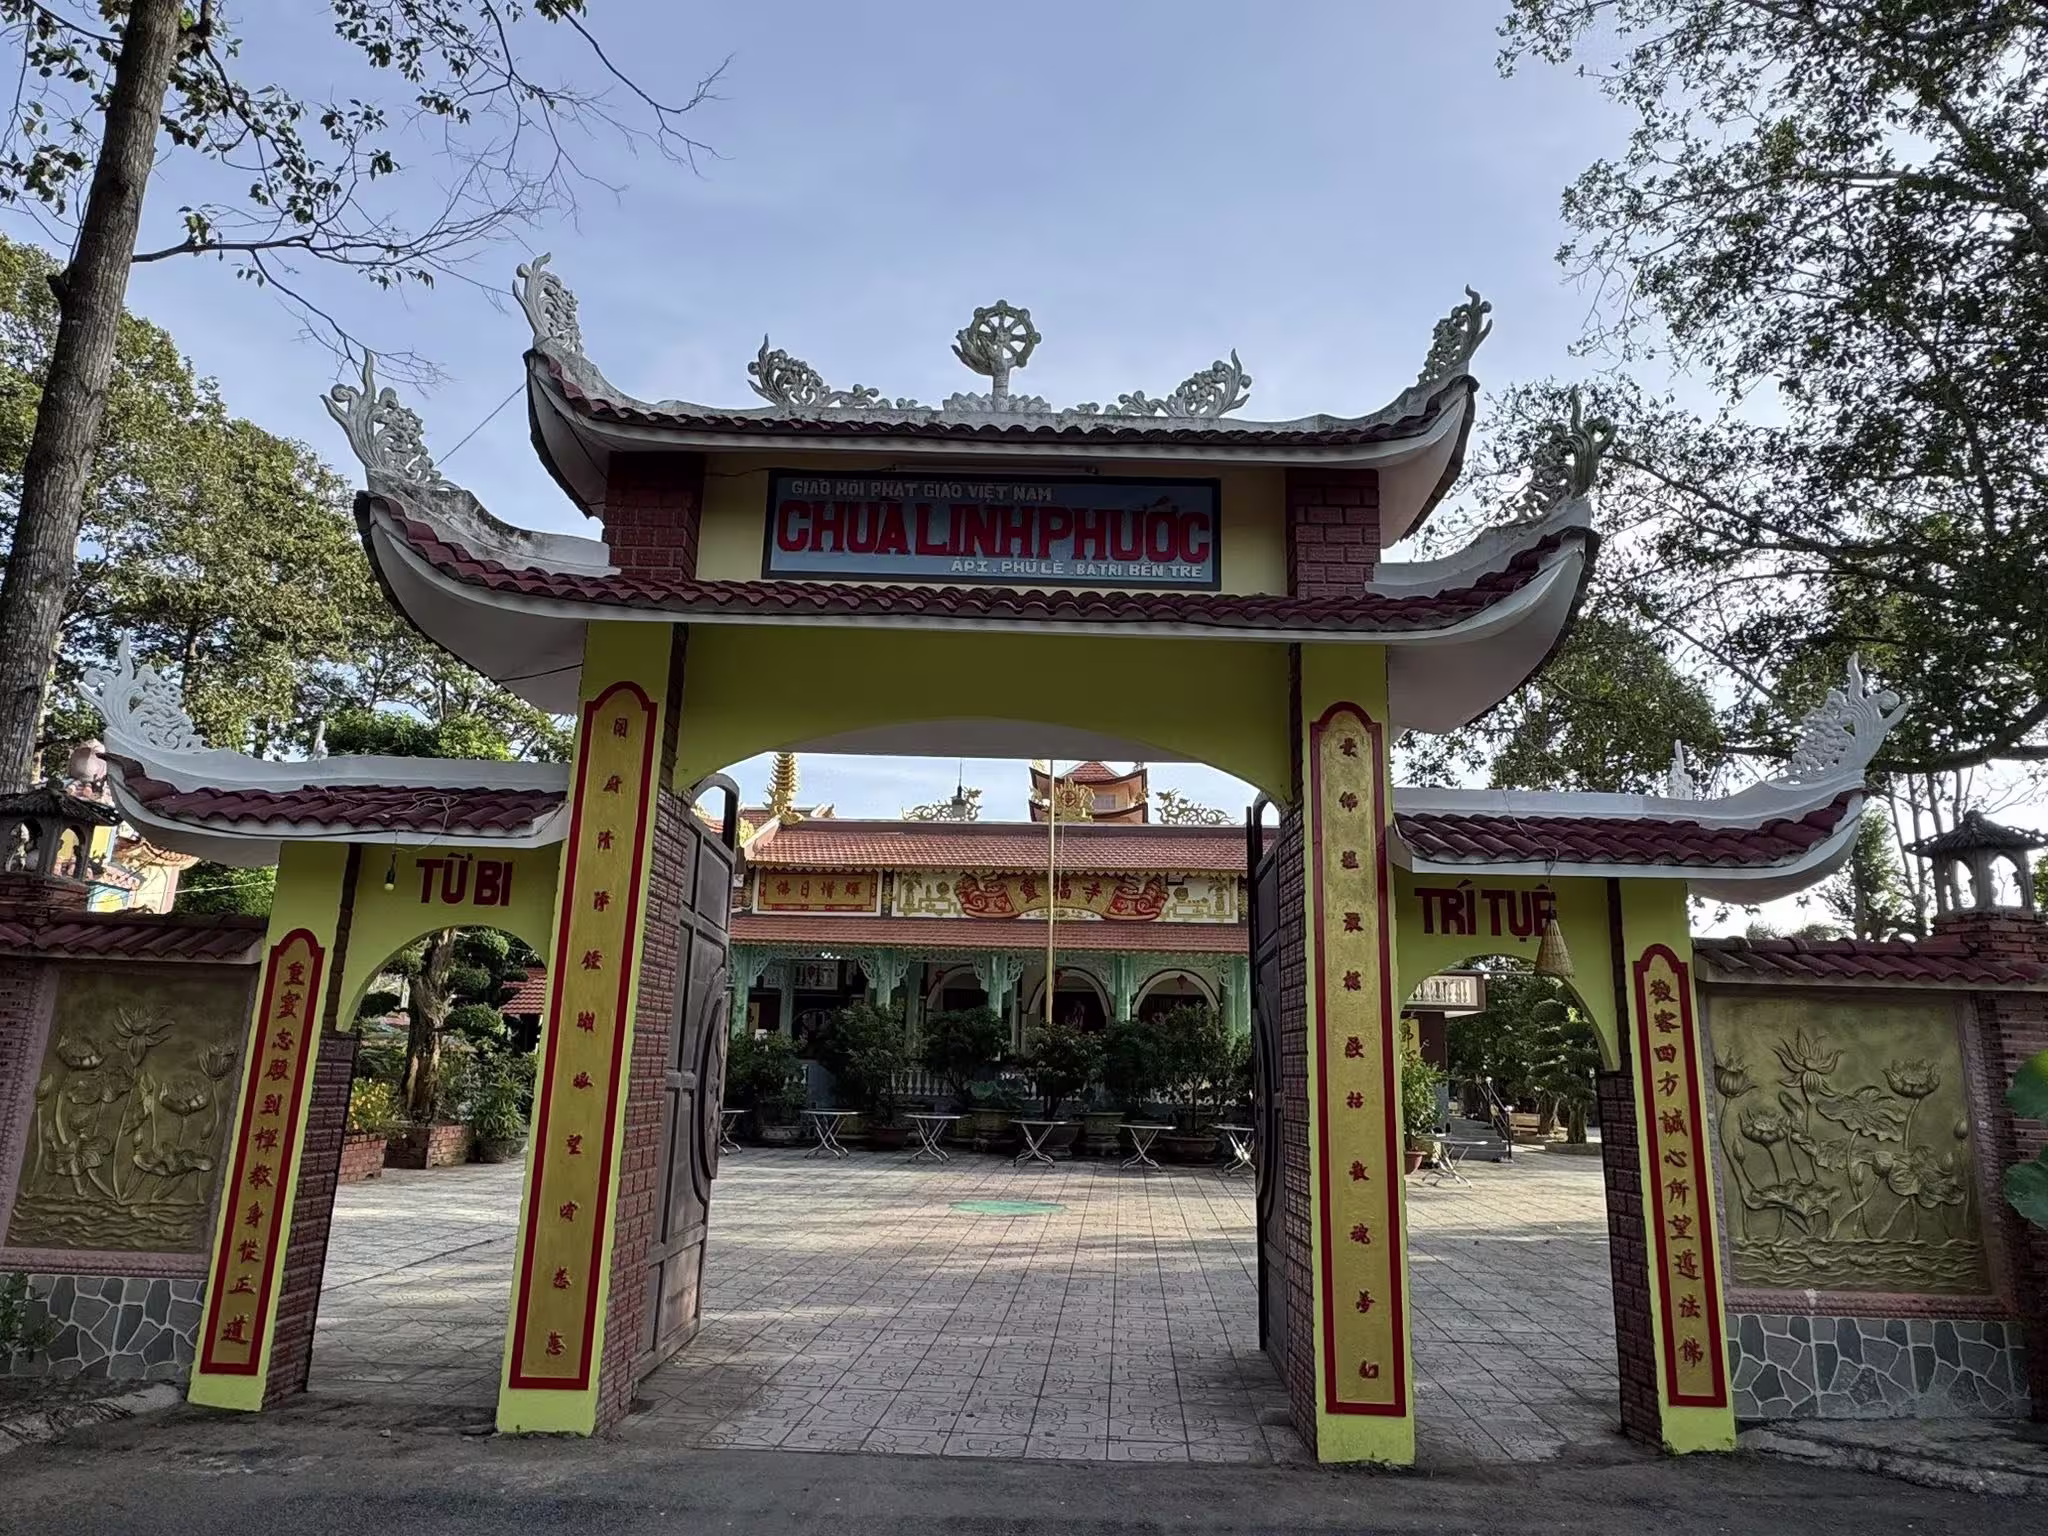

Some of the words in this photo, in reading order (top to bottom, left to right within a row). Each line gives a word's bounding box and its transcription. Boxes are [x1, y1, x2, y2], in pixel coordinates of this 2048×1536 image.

[1013, 485, 1052, 501] NAM
[915, 502, 1033, 559] LINH
[1168, 564, 1203, 578] TRE
[416, 852, 473, 904] TỪ
[473, 860, 513, 906] BI
[1414, 878, 1477, 935] TRÍ
